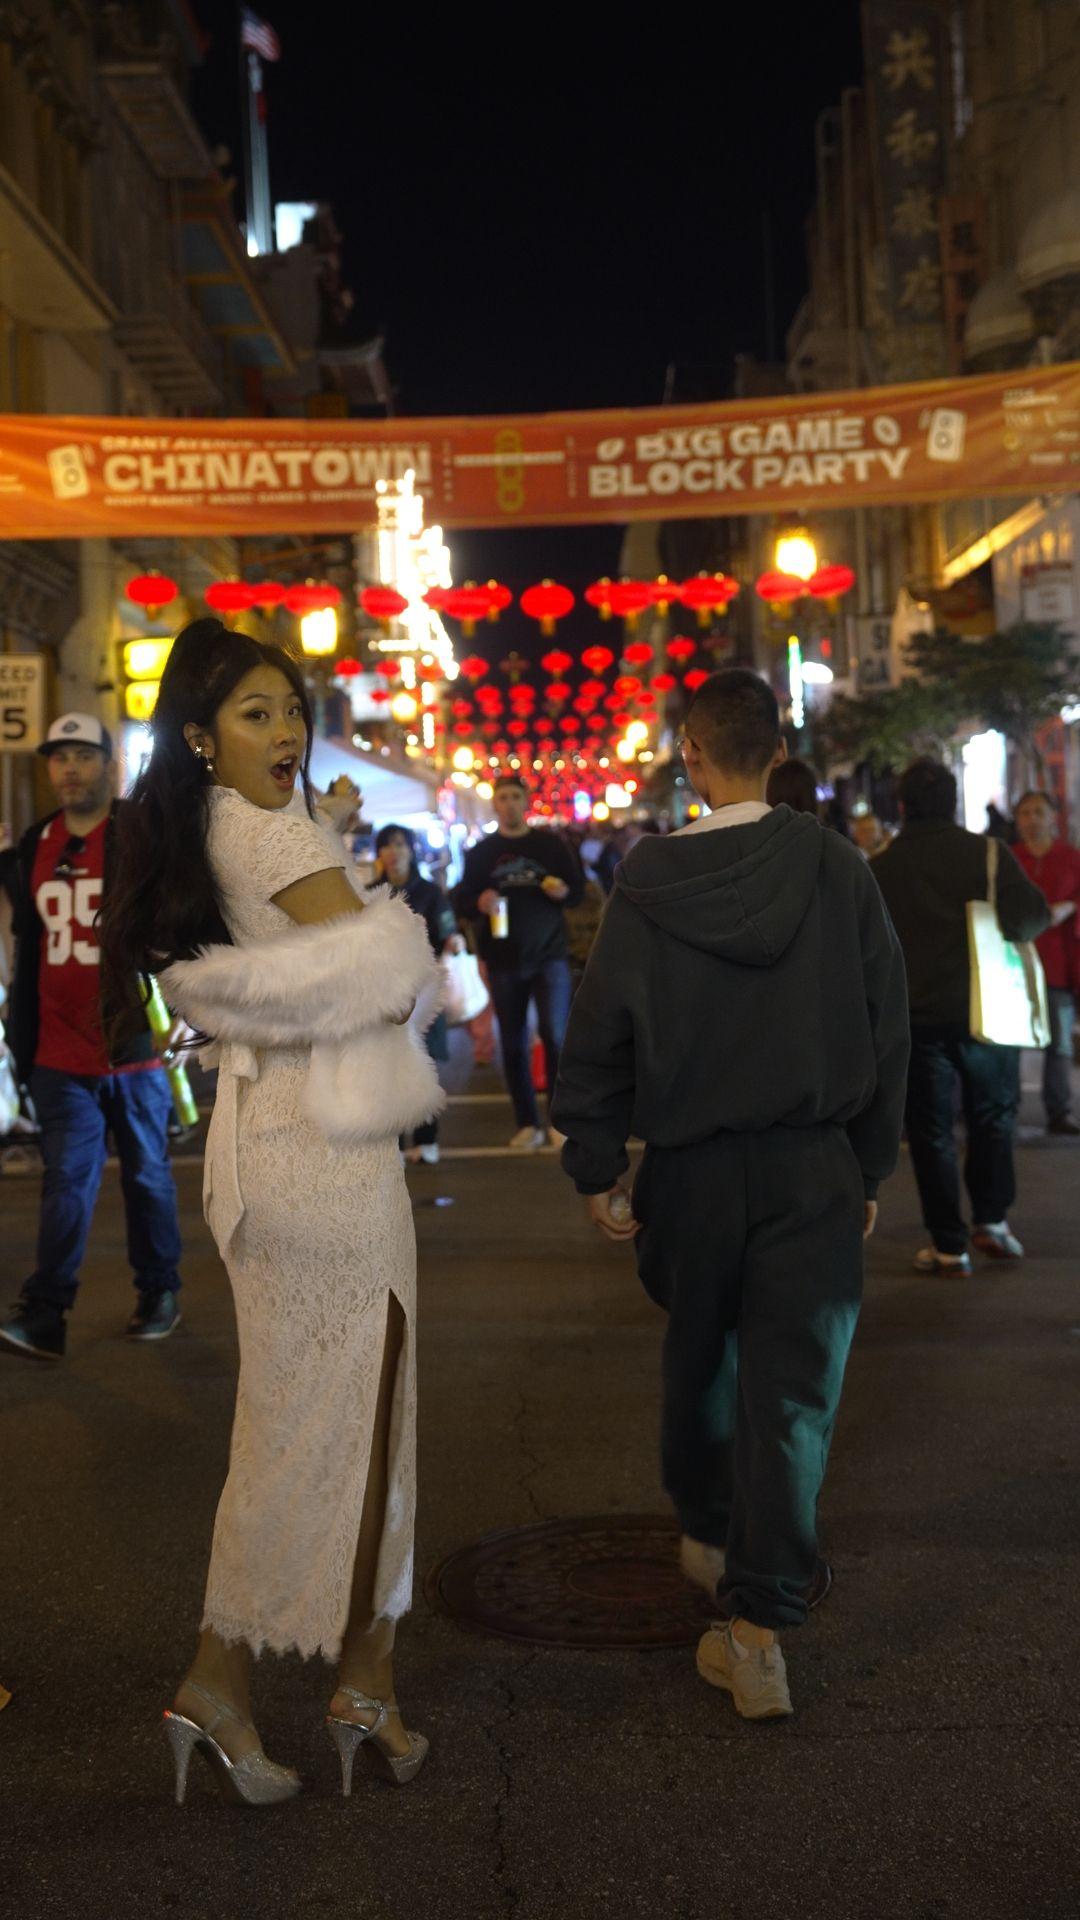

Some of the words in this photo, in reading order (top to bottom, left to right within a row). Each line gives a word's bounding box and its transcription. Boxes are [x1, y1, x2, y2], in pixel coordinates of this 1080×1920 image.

[635, 428, 723, 460] BIG
[729, 417, 864, 455] GAME
[103, 450, 431, 491] CHINATOWN
[588, 459, 745, 497] BLOCK
[752, 448, 910, 489] PARTY
[0, 665, 36, 682] EED
[0, 684, 27, 700] MIT
[3, 707, 28, 740] 5
[36, 878, 103, 965] 85
